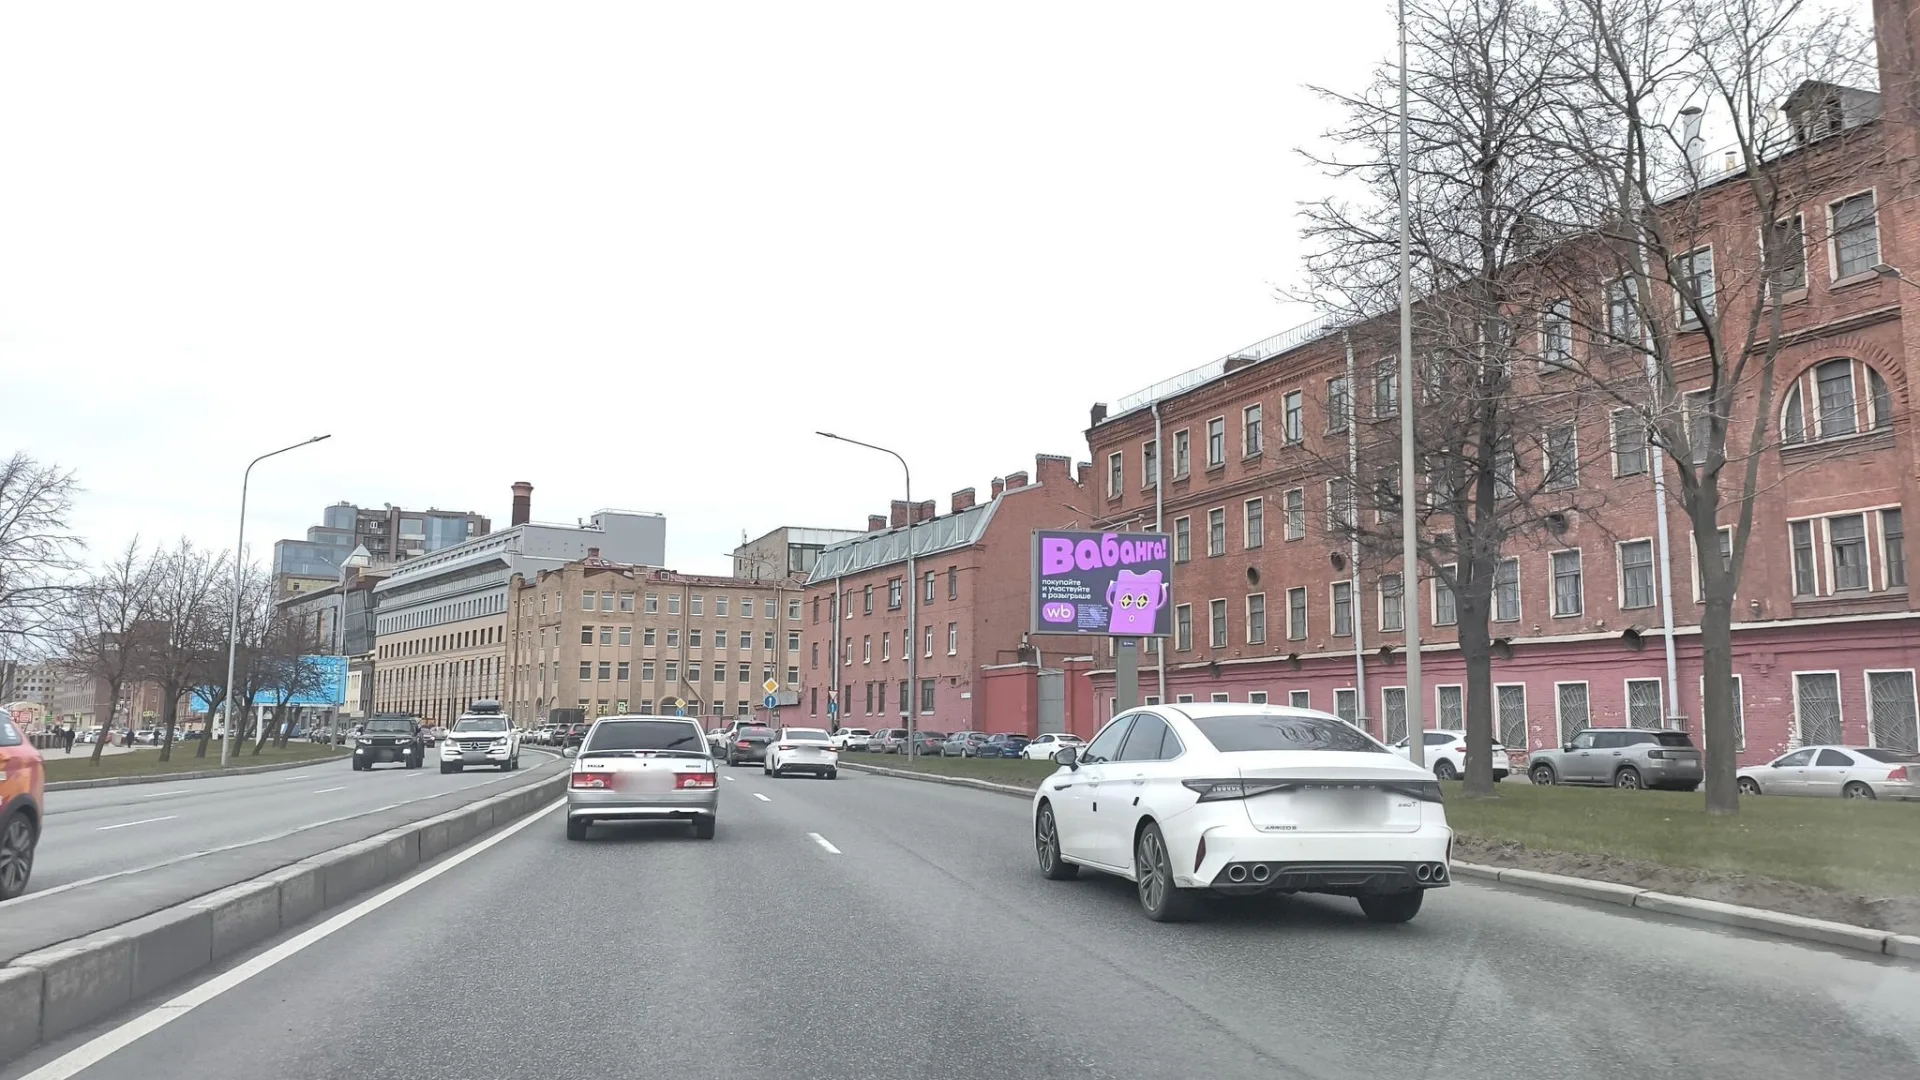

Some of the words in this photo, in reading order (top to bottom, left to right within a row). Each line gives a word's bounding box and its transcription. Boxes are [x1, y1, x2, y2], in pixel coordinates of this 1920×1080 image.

[1042, 533, 1168, 575] Вабанга!
[1042, 579, 1081, 587] покупайте
[1048, 586, 1091, 594] участвуйте
[1047, 604, 1072, 619] wb
